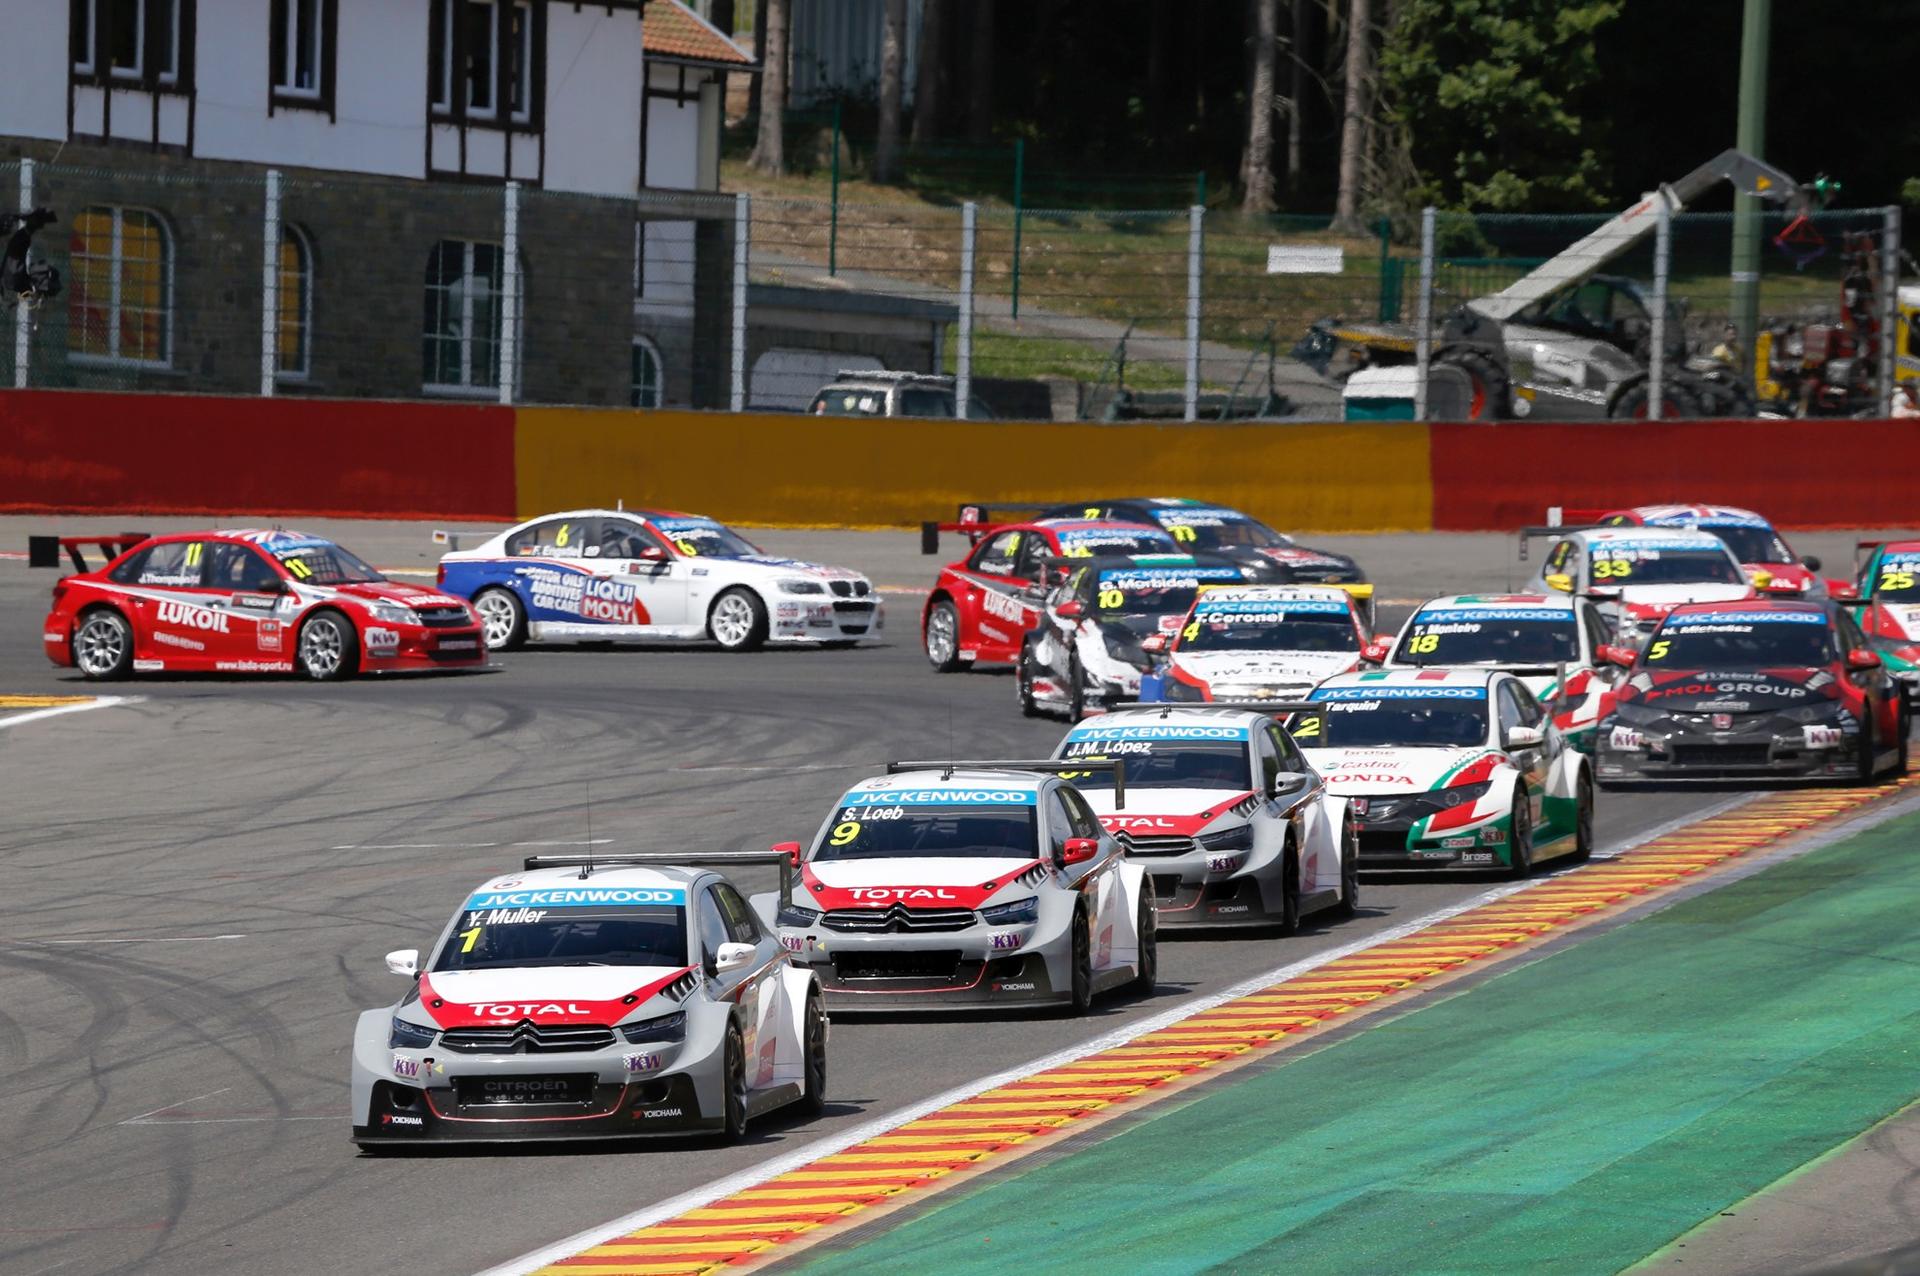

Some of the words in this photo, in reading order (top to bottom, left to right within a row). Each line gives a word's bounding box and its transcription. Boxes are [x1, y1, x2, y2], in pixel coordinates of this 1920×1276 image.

[556, 524, 569, 546] 6
[186, 543, 202, 566] 11
[675, 539, 697, 556] 6
[284, 558, 312, 580] 11
[1593, 561, 1632, 578] 33
[1879, 573, 1915, 590] 25
[586, 579, 635, 604] LIQUI
[1098, 591, 1124, 608] 10
[584, 598, 634, 623] MOLY
[1202, 602, 1341, 613] JVCKENWOOD
[1424, 610, 1568, 621] JVCKENWOOD
[157, 601, 231, 634] LUKOIL
[1671, 613, 1820, 624] JVCKENWOOD
[371, 631, 397, 644] KW
[1183, 623, 1200, 642] 4
[1409, 635, 1440, 654] 18
[1648, 641, 1672, 659] 5
[1318, 689, 1478, 700] JVCKENWOOD
[1324, 700, 1382, 713] Tarquini
[1078, 727, 1241, 740] JVCKENWOOD
[1293, 718, 1320, 736] 2
[1614, 733, 1638, 746] KW
[1811, 732, 1838, 744] KW
[1066, 742, 1100, 757] J.M.
[1103, 739, 1152, 755] López
[853, 791, 1027, 803] JVCKENWOOD
[841, 807, 857, 822] S.
[861, 805, 904, 820] Loeb
[1099, 817, 1175, 827] OTAL
[829, 821, 861, 846] 9
[1461, 852, 1493, 861] brose
[477, 891, 673, 906] JVCKENWOOD
[848, 887, 956, 899] TOTAL
[468, 910, 481, 927] Y.
[486, 908, 548, 925] Muller
[459, 927, 482, 953] 1
[994, 934, 1022, 949] KW
[1001, 981, 1035, 990] YOKOHAMA
[468, 1003, 591, 1017] TOTAL
[395, 1059, 419, 1077] KW
[629, 1055, 662, 1071] KW
[391, 1115, 423, 1125] YOKOHAMA
[643, 1108, 683, 1118] YOKOHAMA
